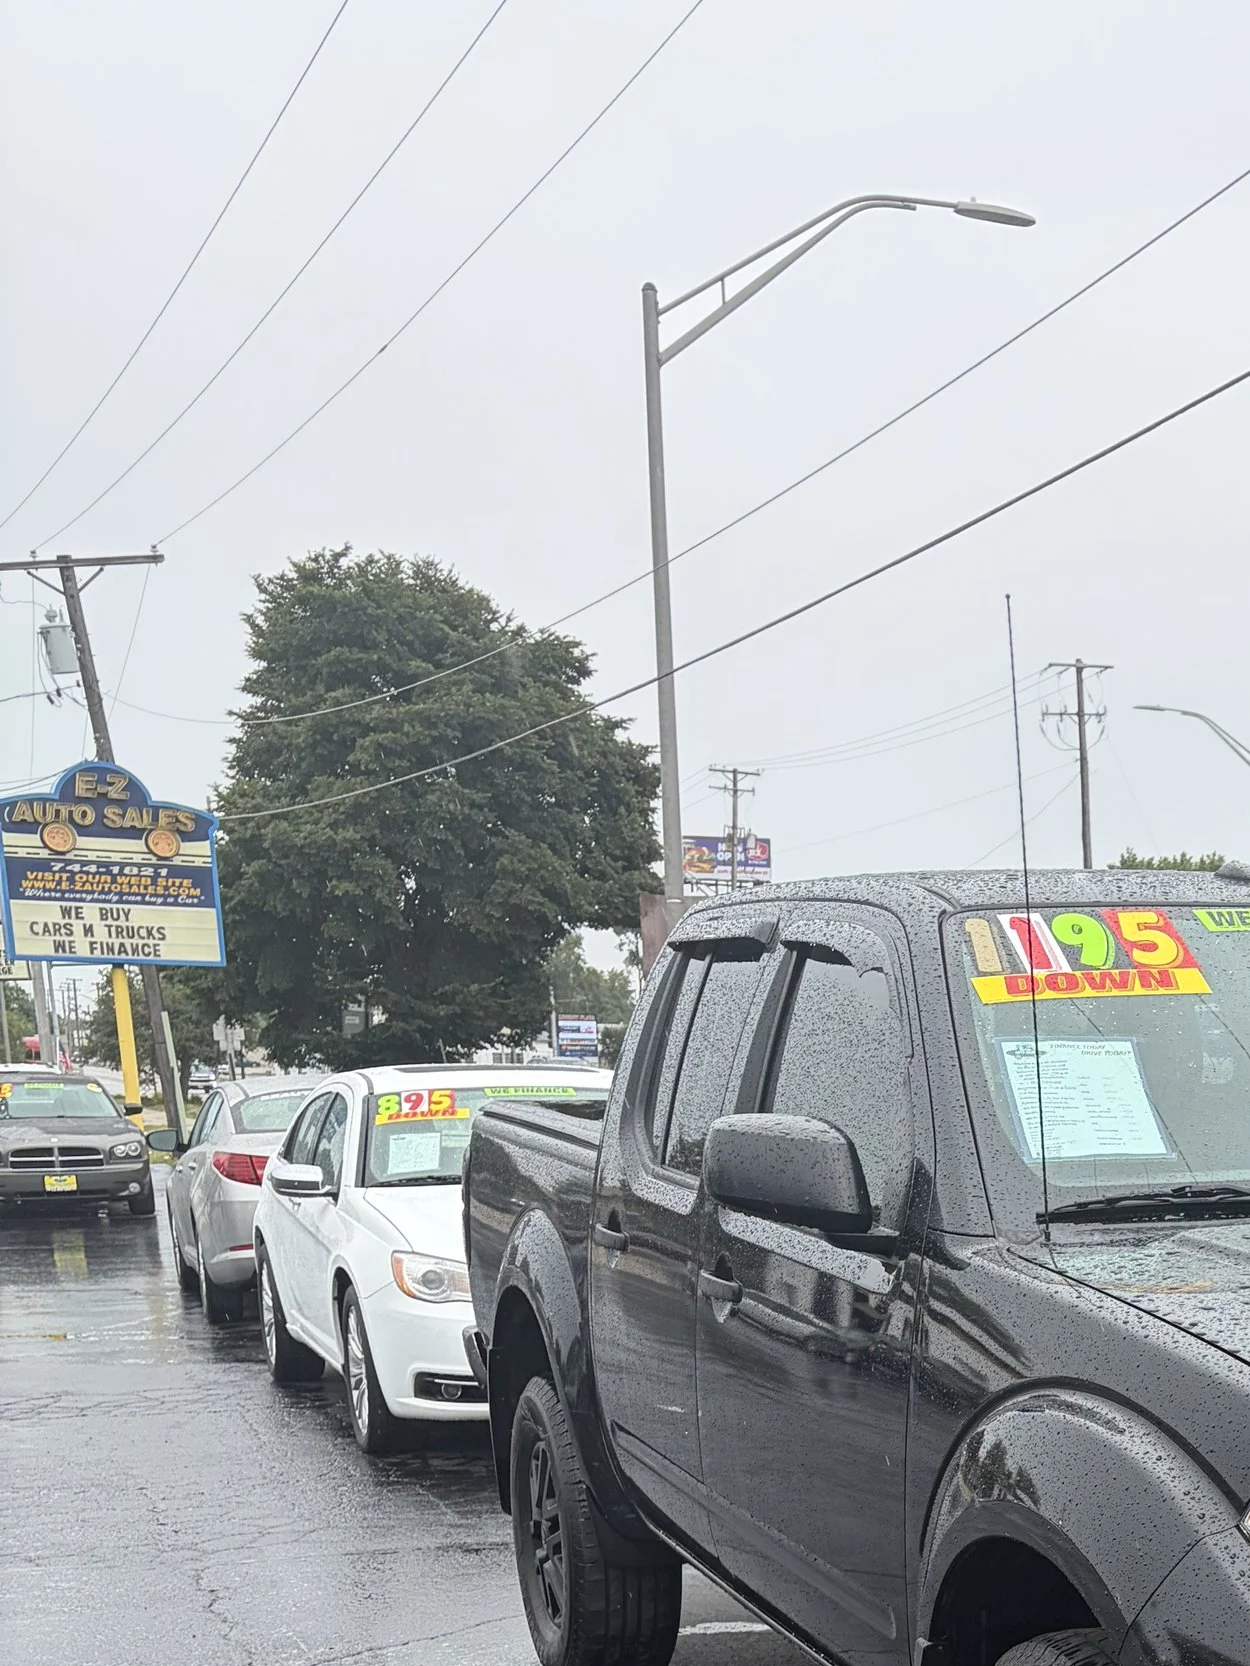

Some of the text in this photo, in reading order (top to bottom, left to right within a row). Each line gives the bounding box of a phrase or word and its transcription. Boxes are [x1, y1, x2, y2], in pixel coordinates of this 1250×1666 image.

[75, 772, 130, 800] E-Z
[12, 800, 196, 832] AUTO SALES
[717, 851, 745, 862] OPN
[50, 862, 168, 877] 744-1821
[26, 871, 192, 887] VISIT OUR WEB SITE
[64, 890, 119, 902] everybody
[145, 893, 163, 905] buy
[59, 905, 131, 923] WE BUY
[29, 921, 74, 937] CARS
[104, 924, 167, 940] TRUCKS
[53, 940, 162, 958] WE FINANCE
[965, 910, 1185, 975] 1195
[1003, 968, 1180, 997] DOWN
[490, 1086, 568, 1095] WE FINANCE
[377, 1089, 453, 1116] 895
[387, 1108, 458, 1121] DOWN
